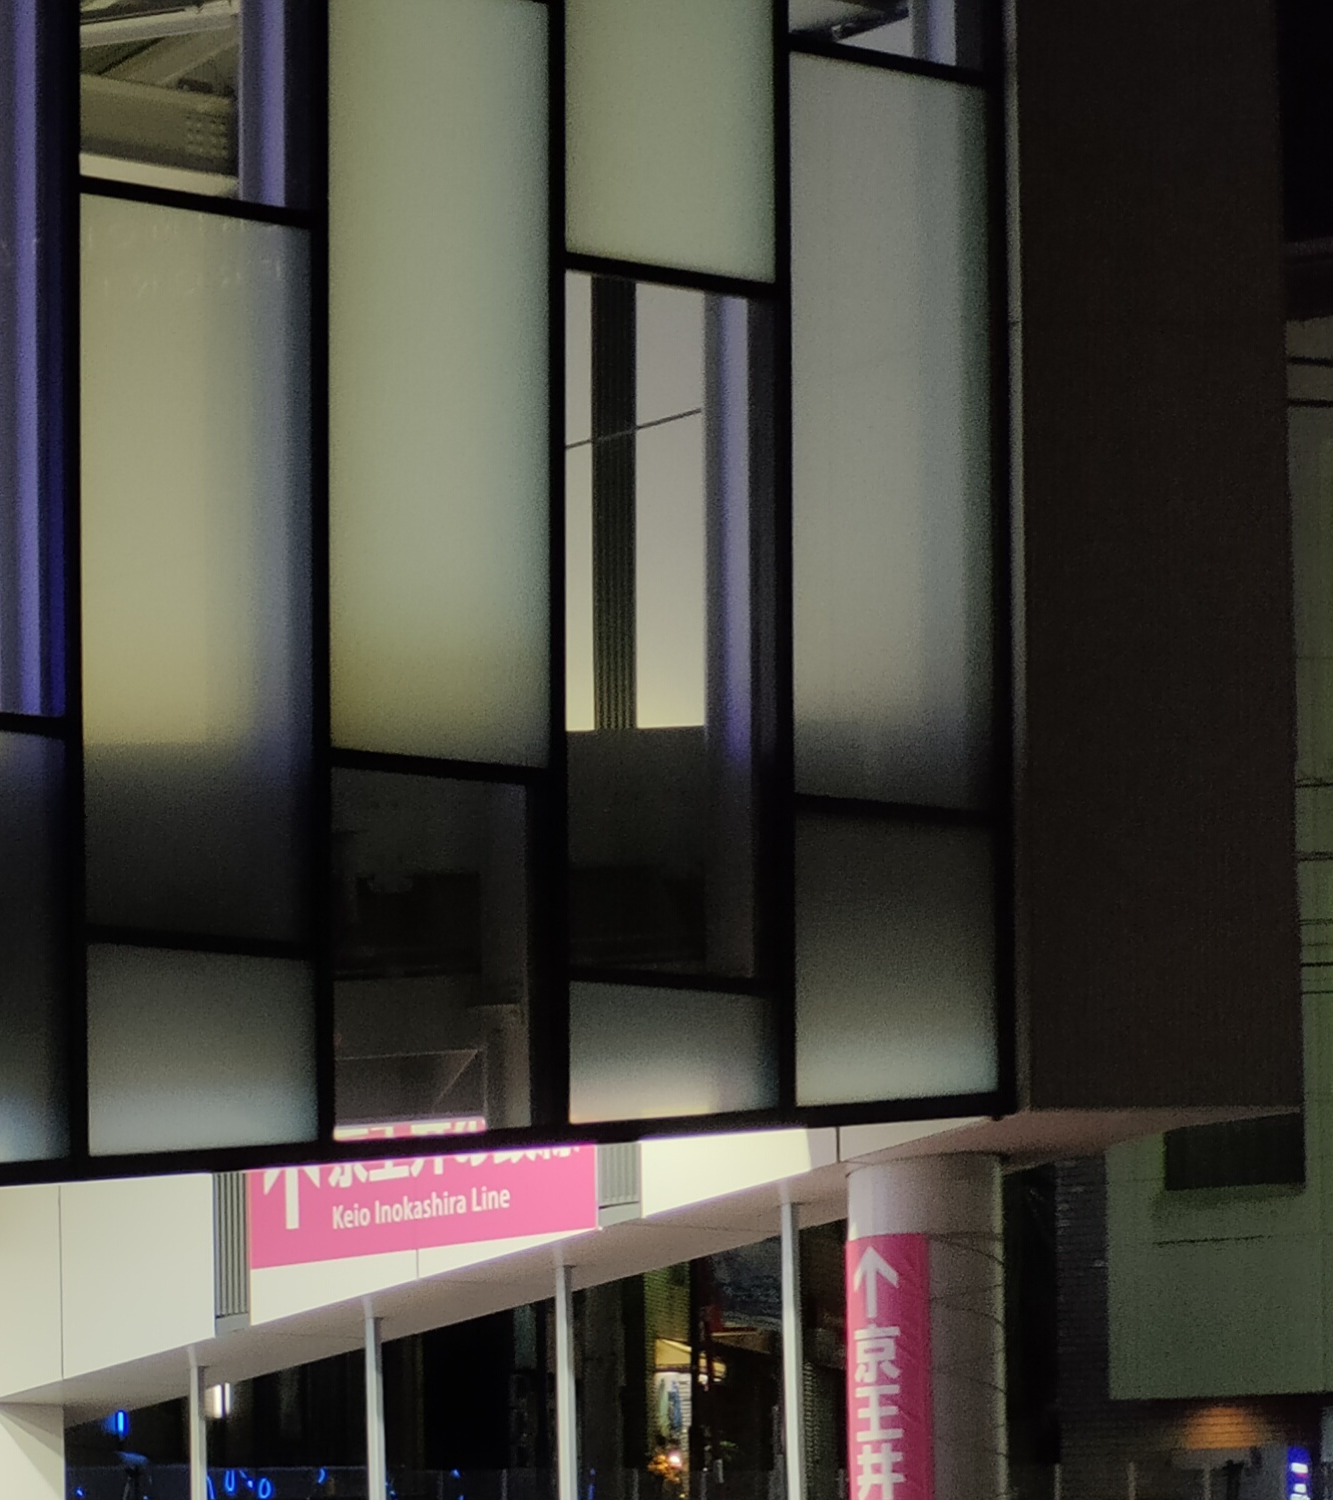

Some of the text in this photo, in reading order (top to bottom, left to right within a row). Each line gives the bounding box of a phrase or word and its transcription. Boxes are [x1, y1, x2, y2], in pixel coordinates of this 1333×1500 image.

[333, 1187, 511, 1230] Keio Inokashira Line
